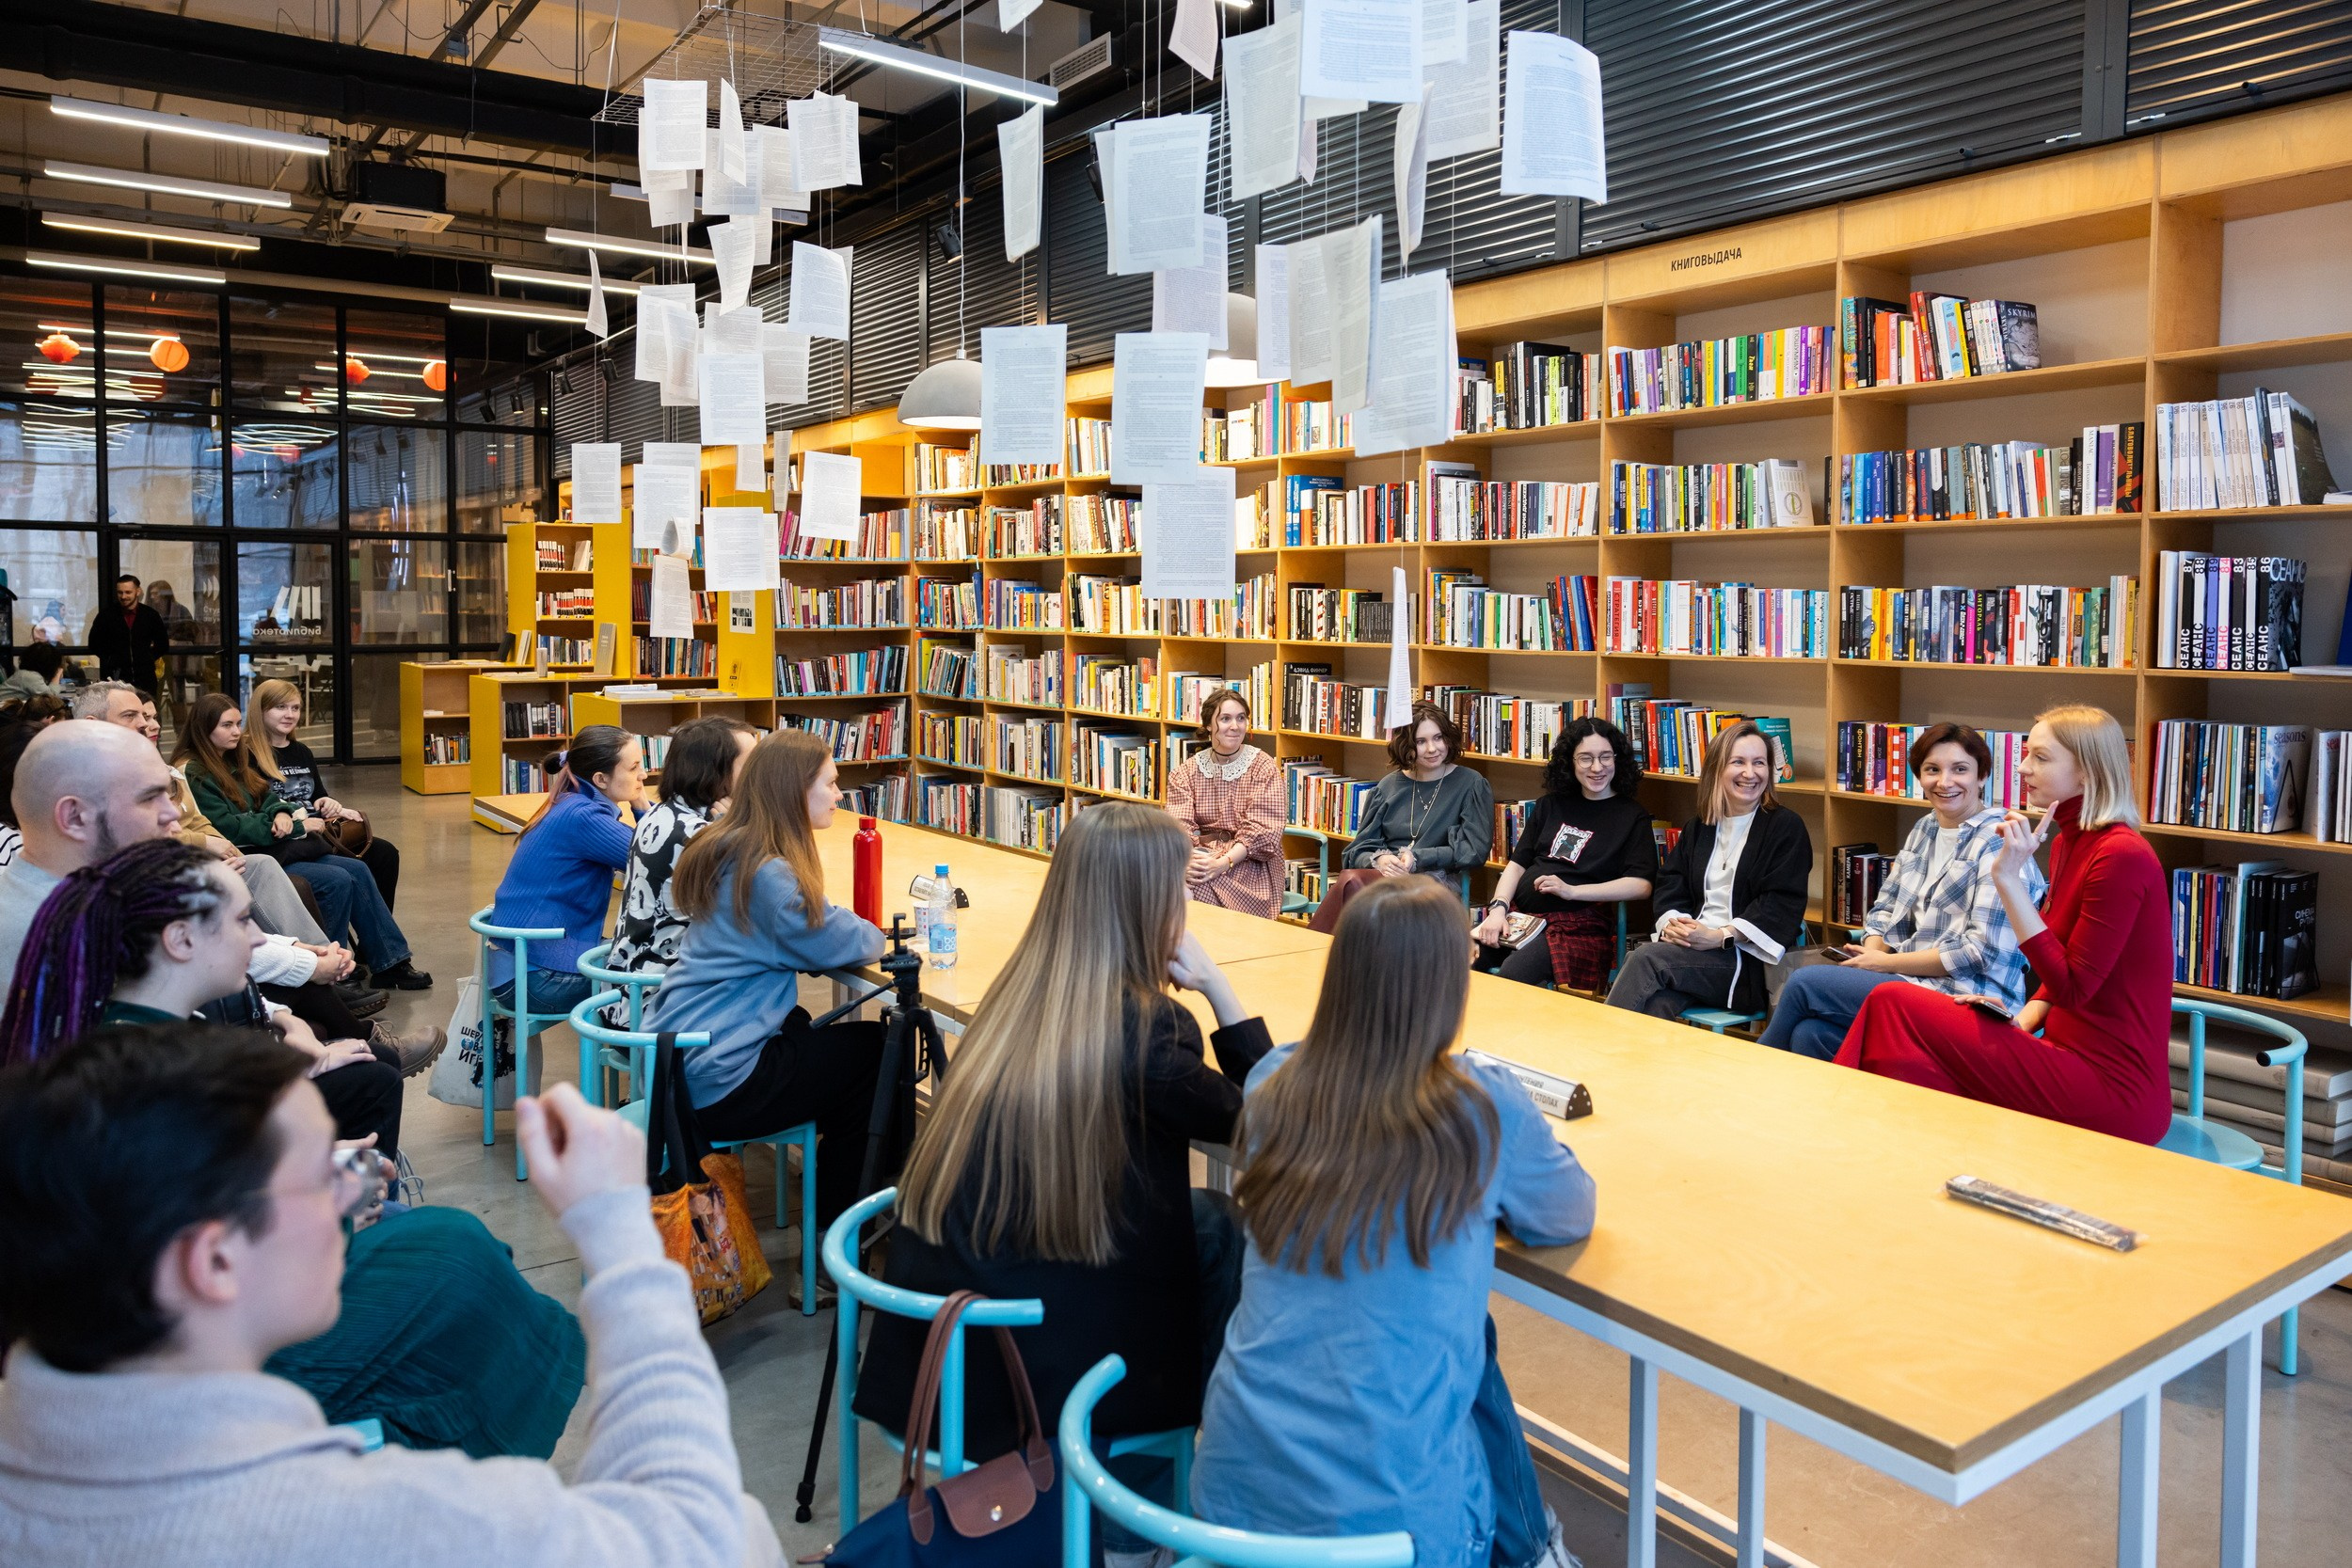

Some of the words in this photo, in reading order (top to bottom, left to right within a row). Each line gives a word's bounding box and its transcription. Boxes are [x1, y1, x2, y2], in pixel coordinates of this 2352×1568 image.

[1670, 246, 1743, 273] КНИГОВЫДАЧА
[2183, 558, 2193, 573] 87
[2195, 557, 2205, 574] 88
[2208, 558, 2218, 573] 89
[2219, 558, 2230, 574] 84
[2233, 557, 2244, 573] 83
[2247, 557, 2257, 571] 85
[2260, 557, 2271, 573] 86
[2180, 628, 2191, 669] СЕАНС
[2192, 622, 2203, 670] СЕАНС
[2205, 626, 2216, 668] СЕАНС
[2217, 626, 2228, 670] СЕАНС
[2231, 626, 2243, 671] СЕАНС
[2246, 632, 2256, 671] СЕАНС
[2257, 625, 2269, 671] СЕАНС
[2274, 730, 2306, 745] seasons
[458, 1049, 484, 1066] ИГР
